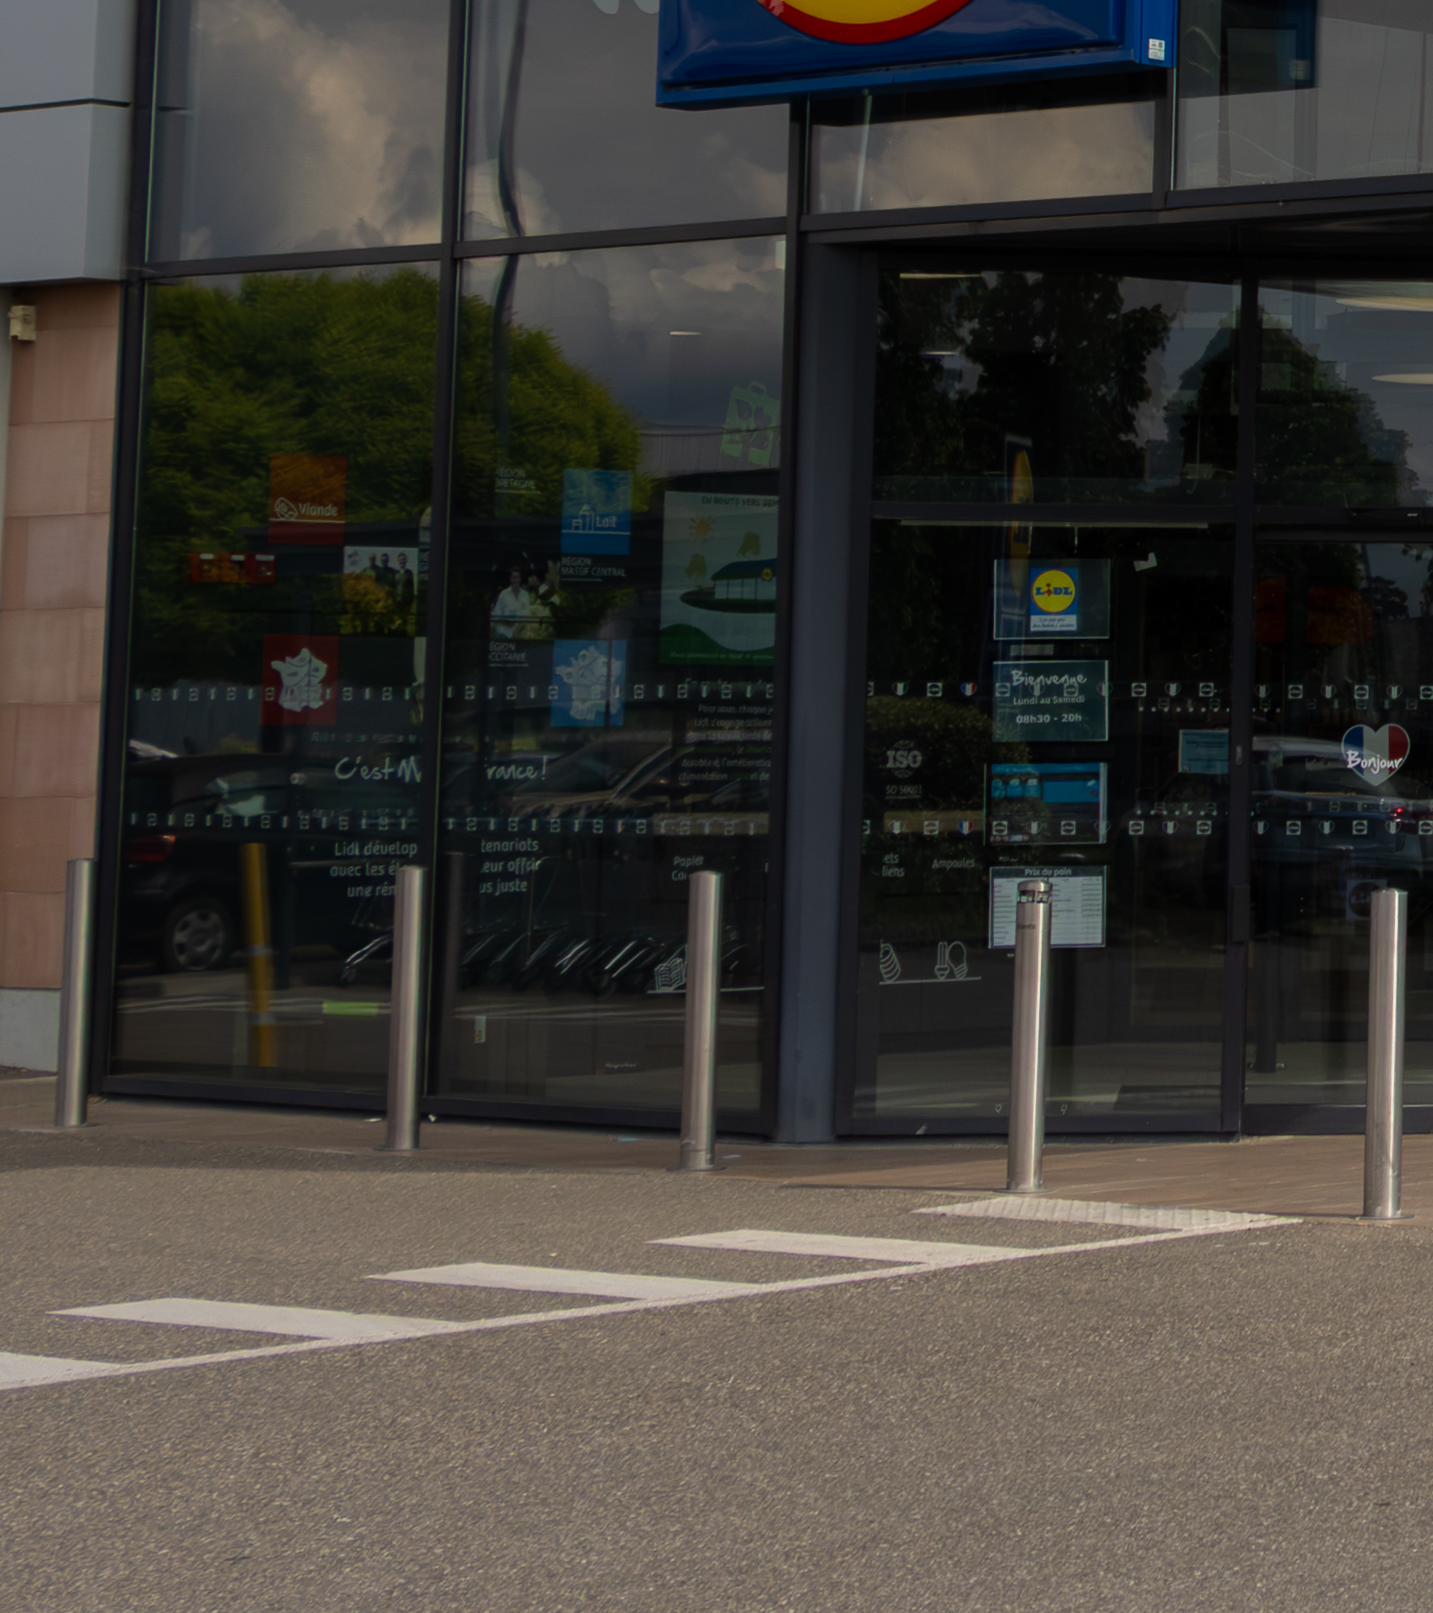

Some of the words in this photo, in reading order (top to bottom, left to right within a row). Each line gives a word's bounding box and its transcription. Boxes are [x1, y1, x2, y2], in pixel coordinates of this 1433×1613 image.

[298, 502, 339, 518] Viande
[595, 514, 618, 529] Lait
[1011, 669, 1087, 688] Bienvenue
[1013, 695, 1038, 705] Lundi
[1040, 697, 1051, 705] au
[1052, 694, 1085, 704] Samedi
[1016, 714, 1050, 724] 08h30
[1061, 713, 1082, 723] 20h
[886, 750, 922, 769] ISO
[1346, 749, 1403, 774] Bonjour
[334, 755, 394, 781] C'est
[484, 755, 547, 781] rance!
[334, 841, 360, 857] Lidl
[363, 839, 418, 859] dévelop
[481, 838, 539, 853] tenariats
[330, 865, 361, 878] avec
[365, 862, 385, 876] les
[673, 855, 705, 869] Papier
[931, 857, 976, 872] Ampoules
[1024, 868, 1041, 877] Prix
[1042, 868, 1053, 876] du
[1054, 867, 1072, 877] pain
[347, 886, 372, 898] une
[495, 878, 528, 897] juste
